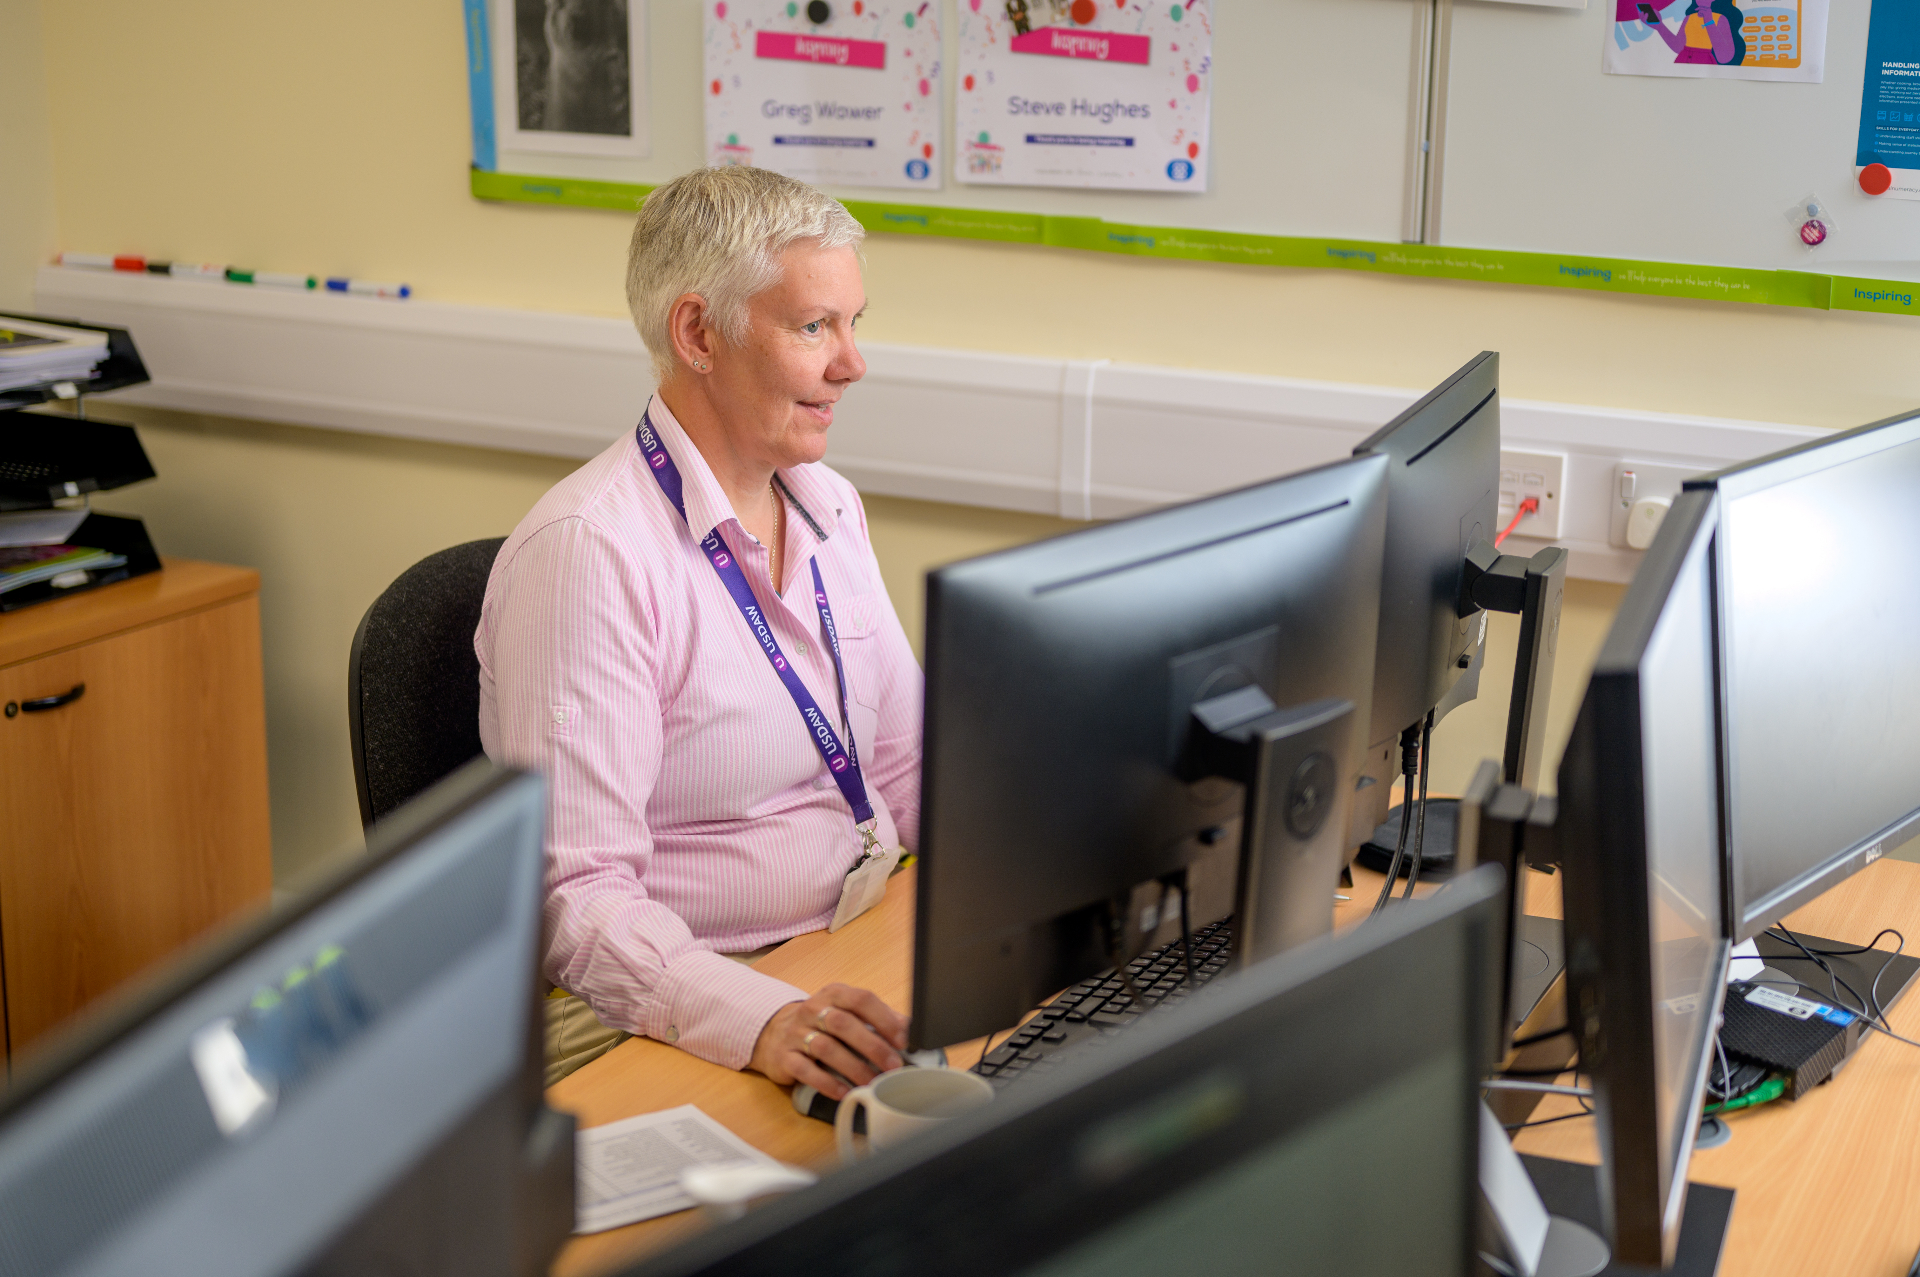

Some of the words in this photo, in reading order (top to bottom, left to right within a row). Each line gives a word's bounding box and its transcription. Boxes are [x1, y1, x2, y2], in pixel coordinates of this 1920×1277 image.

[1882, 61, 1920, 69] HANDLING
[761, 99, 812, 125] Greg
[1007, 96, 1066, 116] Steve
[1071, 98, 1151, 124] Hughes
[1559, 264, 1612, 283] Inspiring
[1854, 288, 1912, 306] Inspiring
[745, 605, 776, 654] USDAW
[821, 608, 840, 657] USDAW
[804, 707, 837, 755] USDAW
